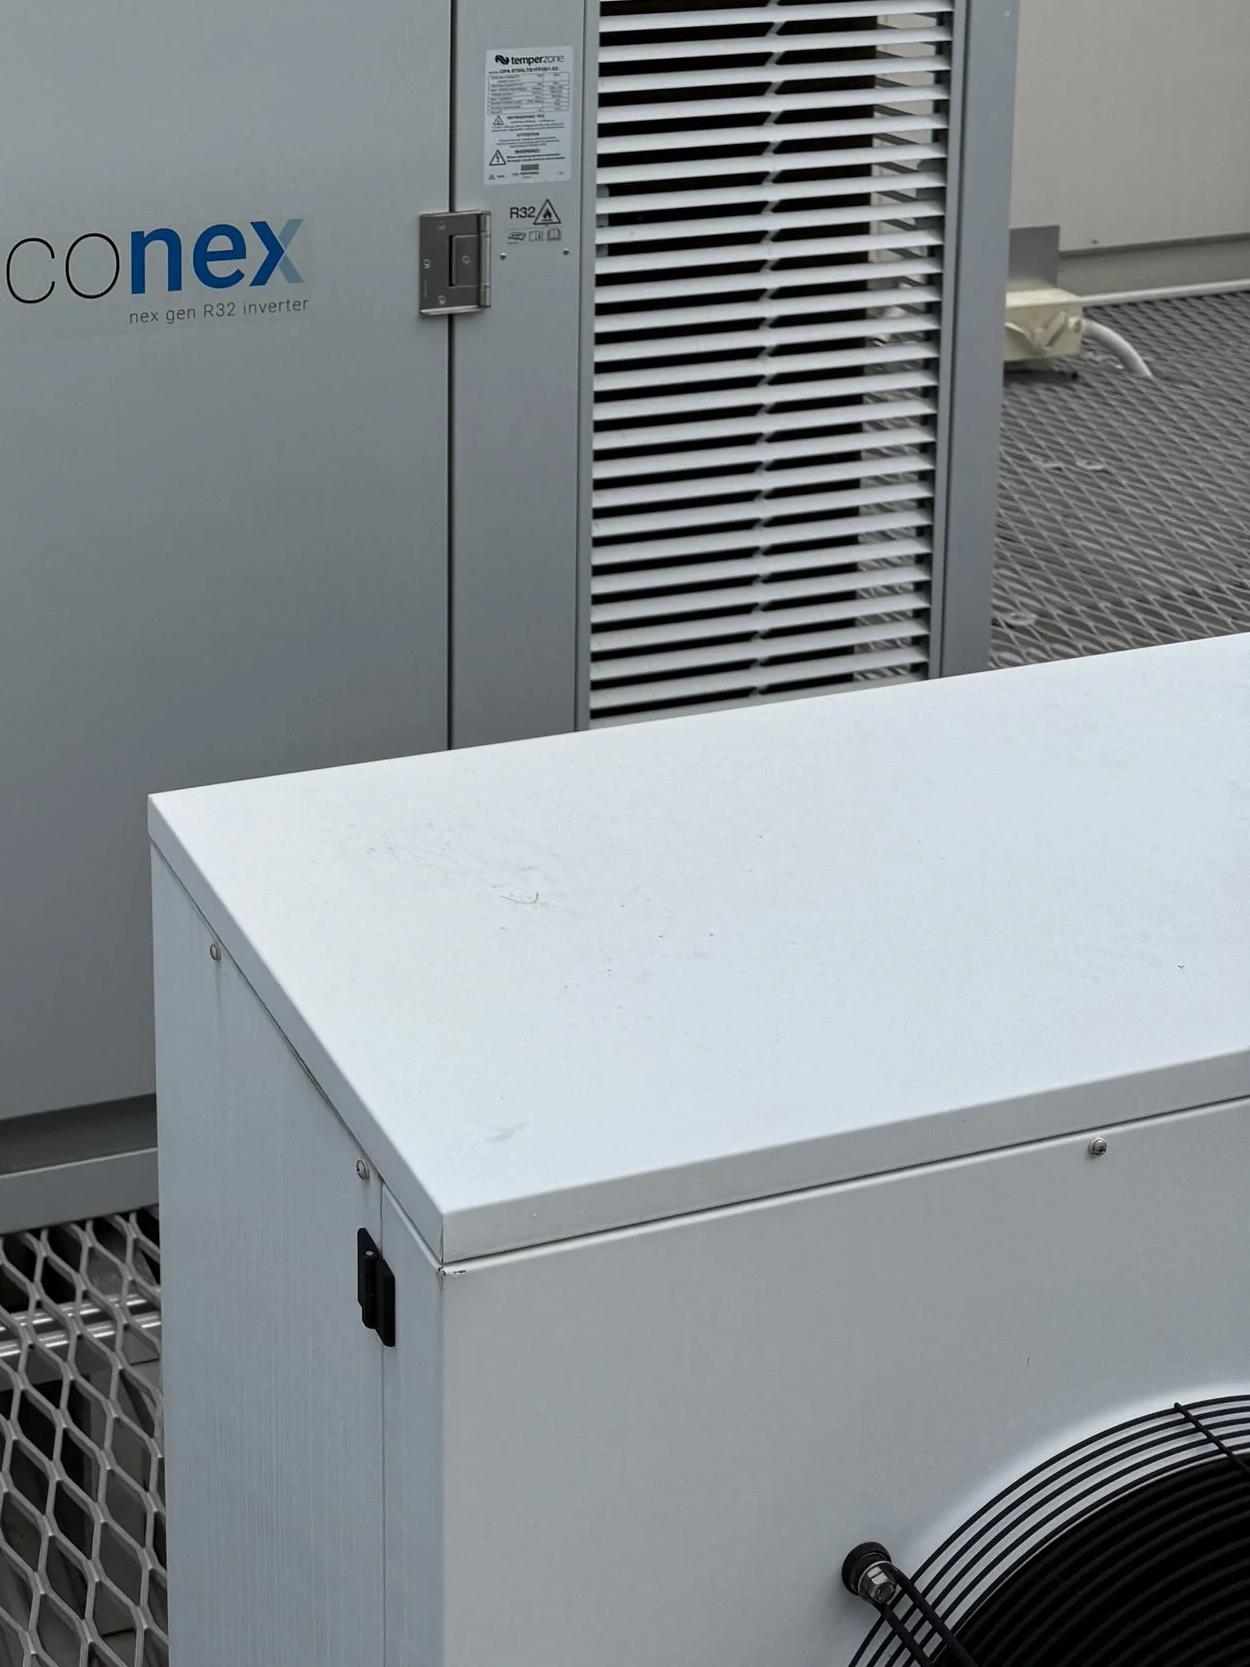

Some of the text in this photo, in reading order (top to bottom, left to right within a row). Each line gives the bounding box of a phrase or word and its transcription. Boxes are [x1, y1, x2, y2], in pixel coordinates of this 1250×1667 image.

[511, 55, 565, 66] temperzone
[510, 206, 536, 219] R32
[129, 297, 309, 325] nex gen R32 inverter
